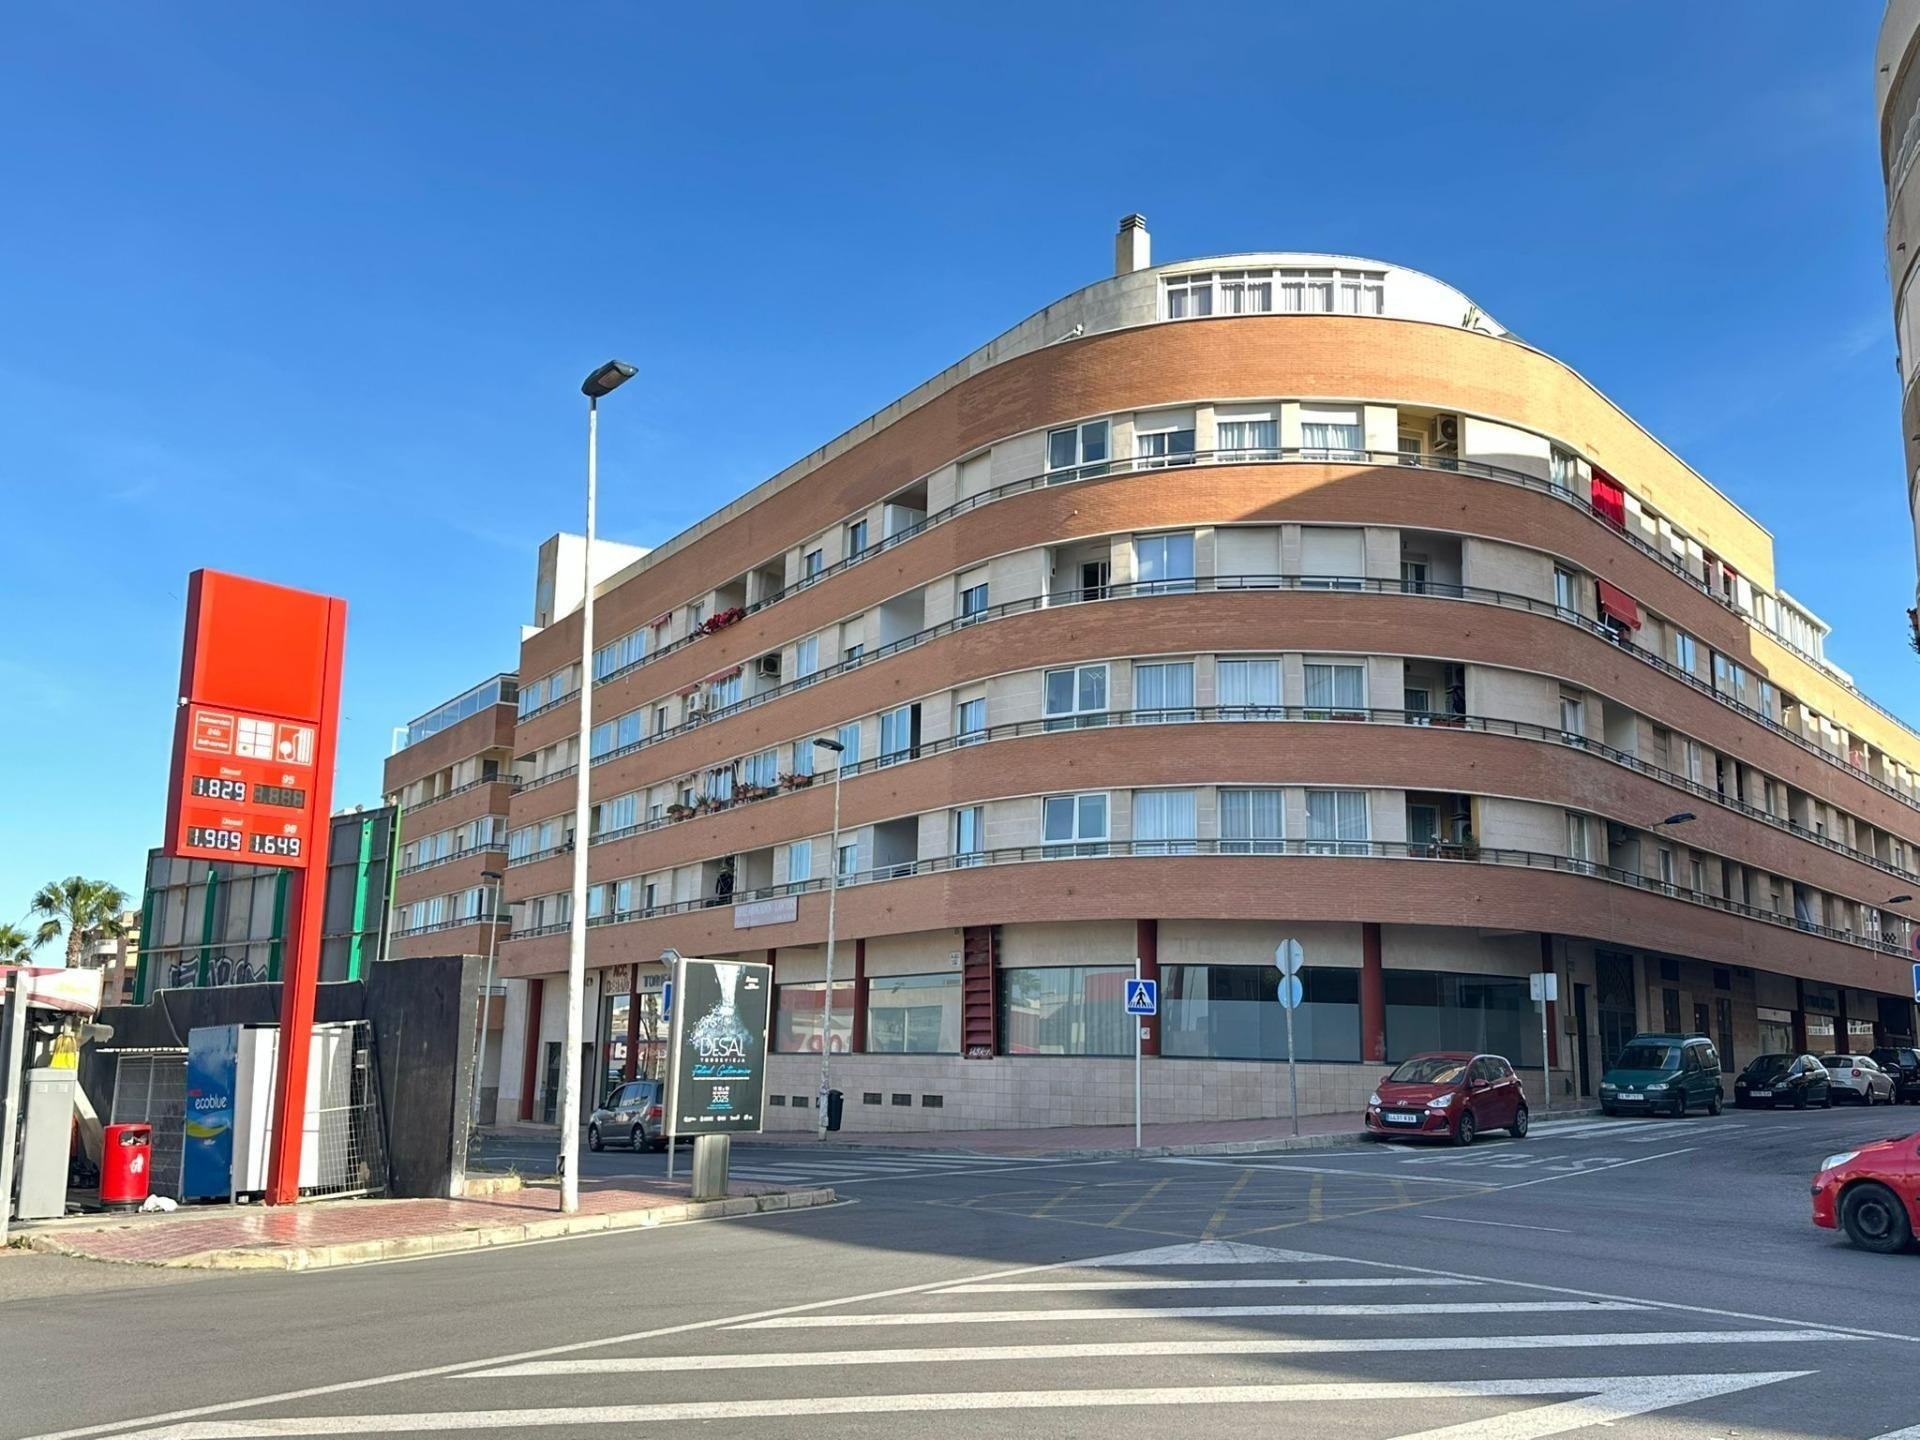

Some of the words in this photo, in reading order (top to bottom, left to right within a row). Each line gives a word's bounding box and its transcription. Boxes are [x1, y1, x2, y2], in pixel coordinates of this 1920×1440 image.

[198, 778, 245, 800] 1.829
[282, 775, 295, 784] 95
[193, 829, 242, 851] 1.909
[254, 835, 300, 857] 1.649
[700, 1037, 746, 1056] DESAL
[195, 1093, 227, 1110] ecoblue
